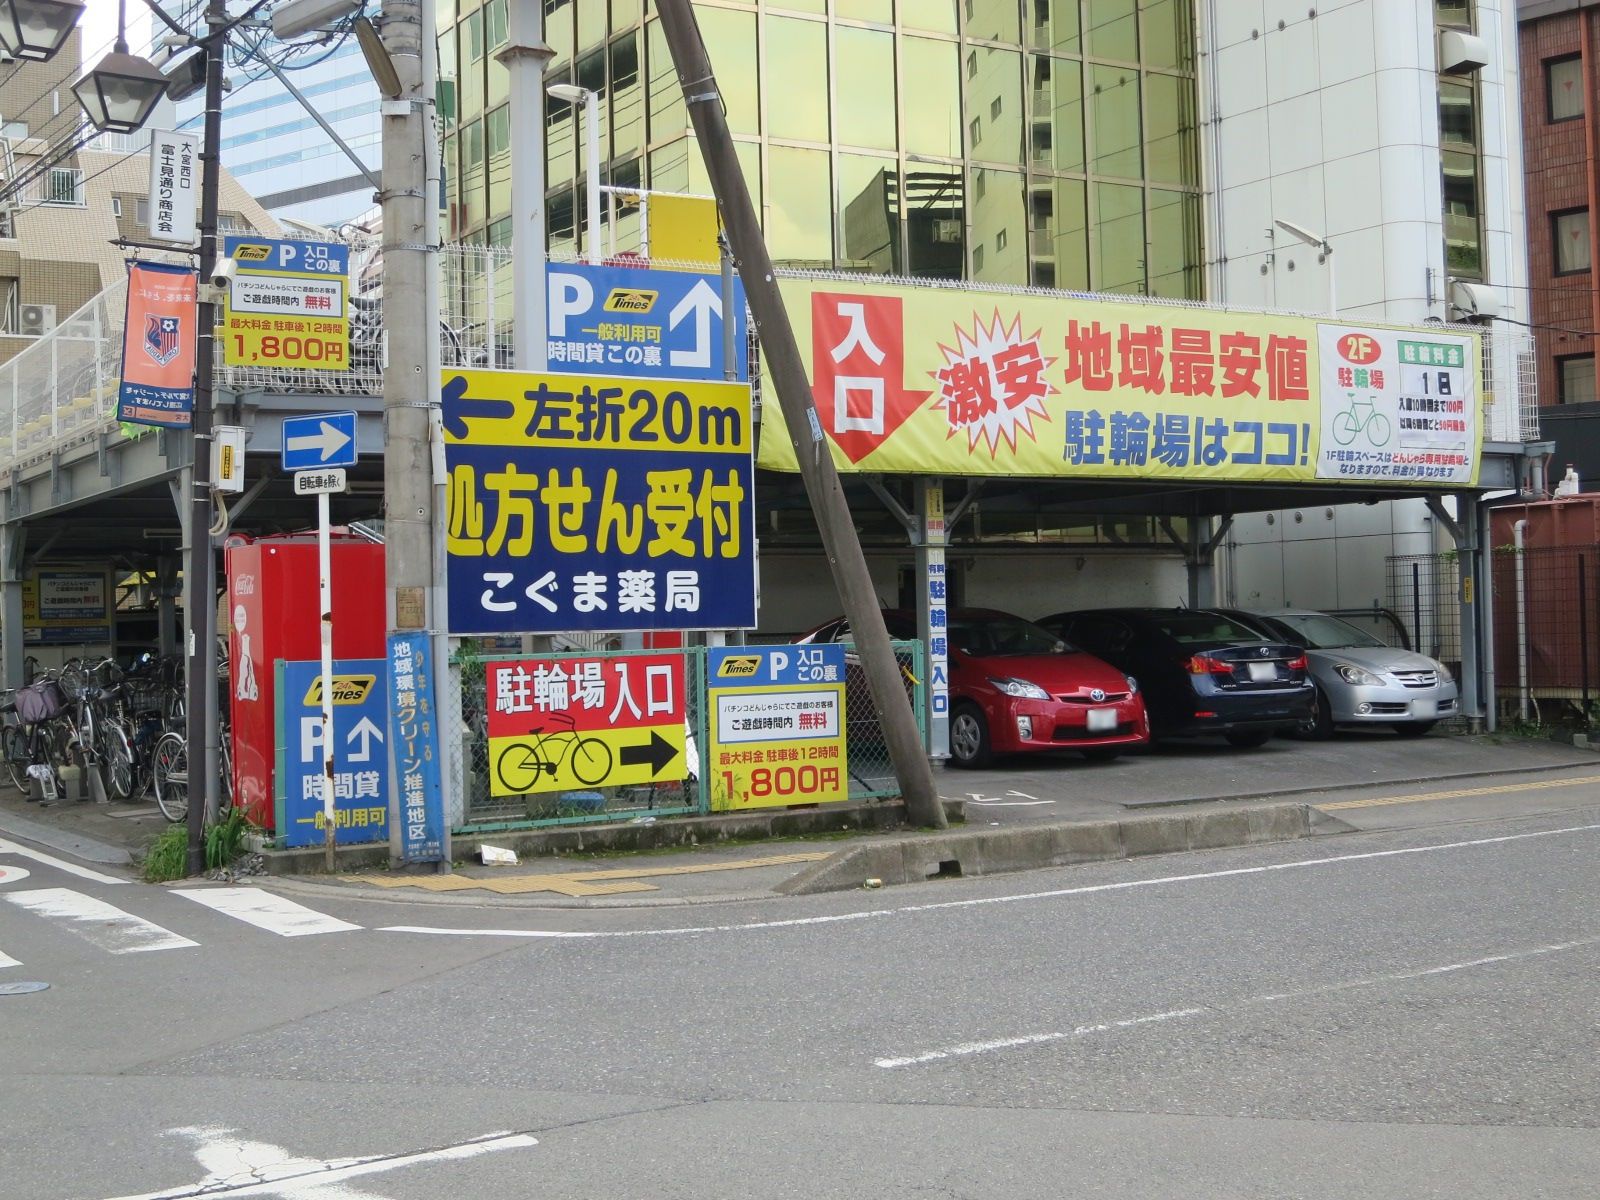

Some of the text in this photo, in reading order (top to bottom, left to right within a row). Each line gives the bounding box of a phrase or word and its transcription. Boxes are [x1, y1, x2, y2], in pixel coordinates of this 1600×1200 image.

[180, 142, 192, 189] 大宮西口
[158, 144, 176, 232] 富士見通り商店会
[280, 244, 296, 267] P
[304, 245, 328, 259] 入口
[304, 259, 341, 273] この裏
[243, 294, 332, 310] ご遊戯時間内 無料
[548, 272, 594, 337] P
[613, 296, 649, 310] Times
[230, 319, 272, 331] 最大料金
[581, 322, 662, 343] 一般利用可
[233, 334, 343, 362] 1,800円
[547, 341, 662, 366] 時間貸 この裏
[1064, 319, 1310, 401] 地域最安値
[1347, 337, 1373, 361] 2F
[830, 302, 886, 436] 入口
[1337, 367, 1384, 390] 駐輪場
[938, 340, 1049, 429] 激安
[523, 382, 742, 446] 左折20m
[1062, 409, 1311, 468] 駐輪場はココ!
[299, 474, 340, 490] 自転車を除く
[446, 462, 744, 559] 処方せん受付
[480, 569, 700, 614] こぐま薬局
[796, 649, 824, 666] 入口
[929, 580, 947, 713] 駐輪場入口
[725, 662, 754, 676] Times
[769, 651, 789, 681] P
[797, 665, 838, 682] この裏
[495, 662, 675, 725] 駐輪場入口
[731, 711, 828, 731] ご遊戯時間内 無料
[301, 716, 324, 763] P
[393, 641, 426, 840] 地域環境クリーン推進地区
[719, 745, 839, 766] 最大料金 駐車後12時間
[302, 770, 380, 801] 時間貸
[721, 764, 840, 802] 1,800円
